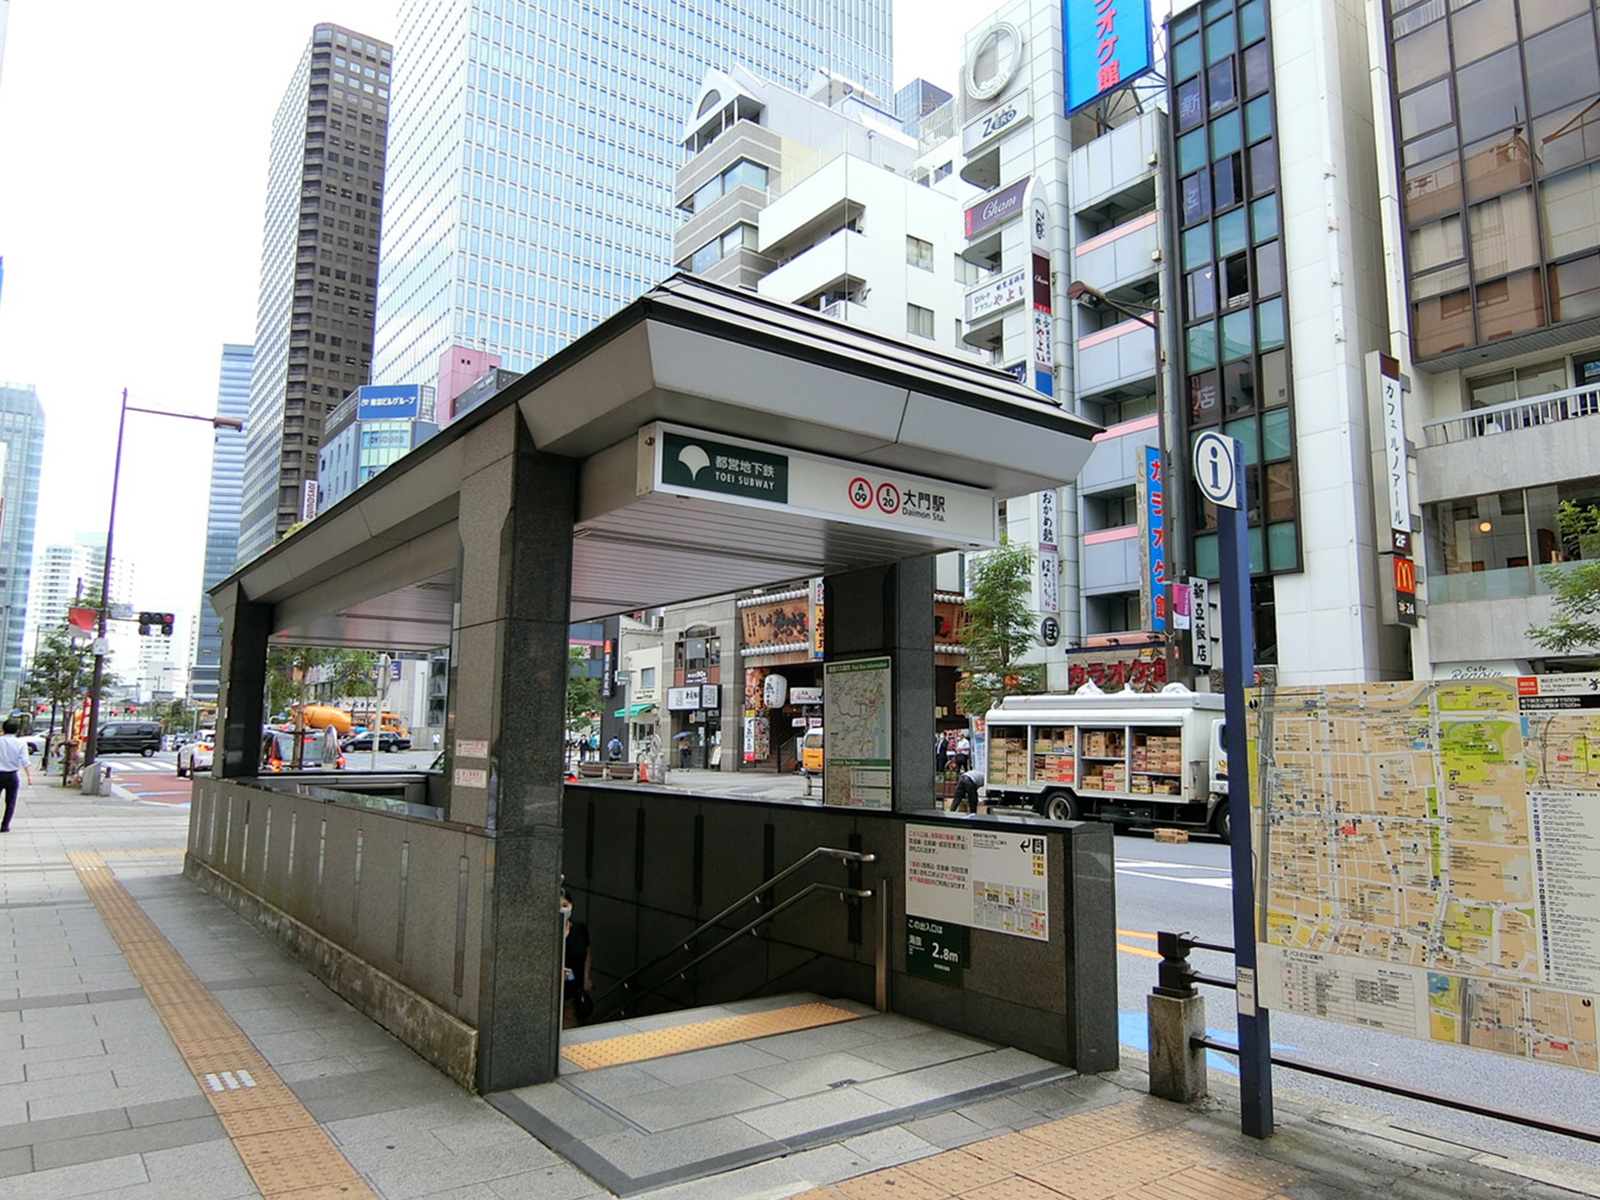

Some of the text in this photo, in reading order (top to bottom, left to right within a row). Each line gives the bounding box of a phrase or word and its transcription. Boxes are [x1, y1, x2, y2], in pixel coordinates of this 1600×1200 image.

[715, 455, 775, 478] 都営地下鉄
[715, 471, 775, 491] TOEI SUBWAY
[858, 482, 864, 491] A
[854, 490, 868, 503] 09
[886, 487, 891, 496] E
[882, 496, 895, 509] 20
[903, 489, 946, 513] 大門駅
[902, 507, 947, 523] Daimon Sta.
[1395, 533, 1406, 548] 2F
[1466, 665, 1487, 673] Cafe
[931, 942, 959, 963] 2.8m
